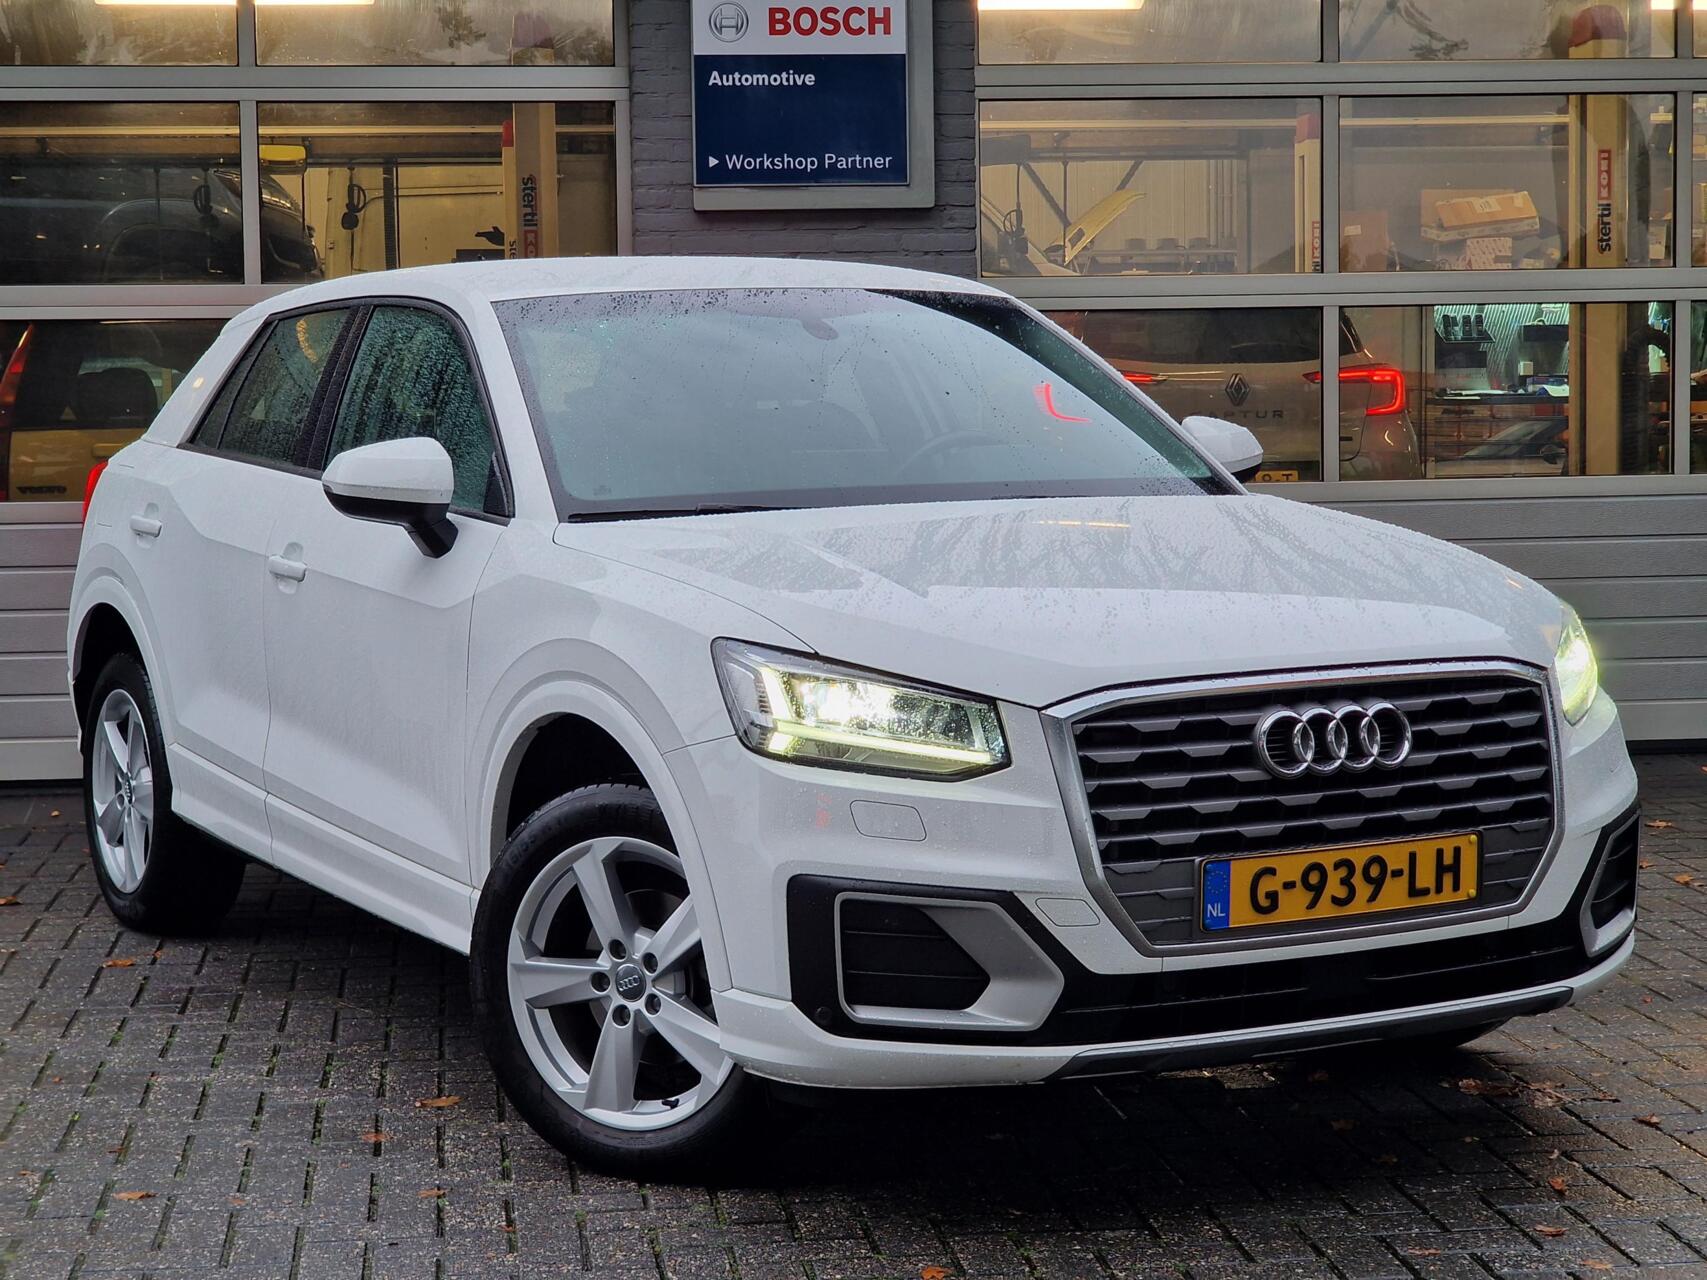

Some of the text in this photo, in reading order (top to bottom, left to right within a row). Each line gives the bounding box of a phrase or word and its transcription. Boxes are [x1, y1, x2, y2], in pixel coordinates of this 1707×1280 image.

[768, 7, 891, 36] BOSCH
[708, 70, 816, 86] Automotive
[725, 153, 893, 172] Workshop Partner
[522, 175, 539, 228] stertil
[1598, 203, 1612, 253] stertil
[1249, 846, 1462, 915] G-939-LH
[1206, 902, 1226, 918] NL
